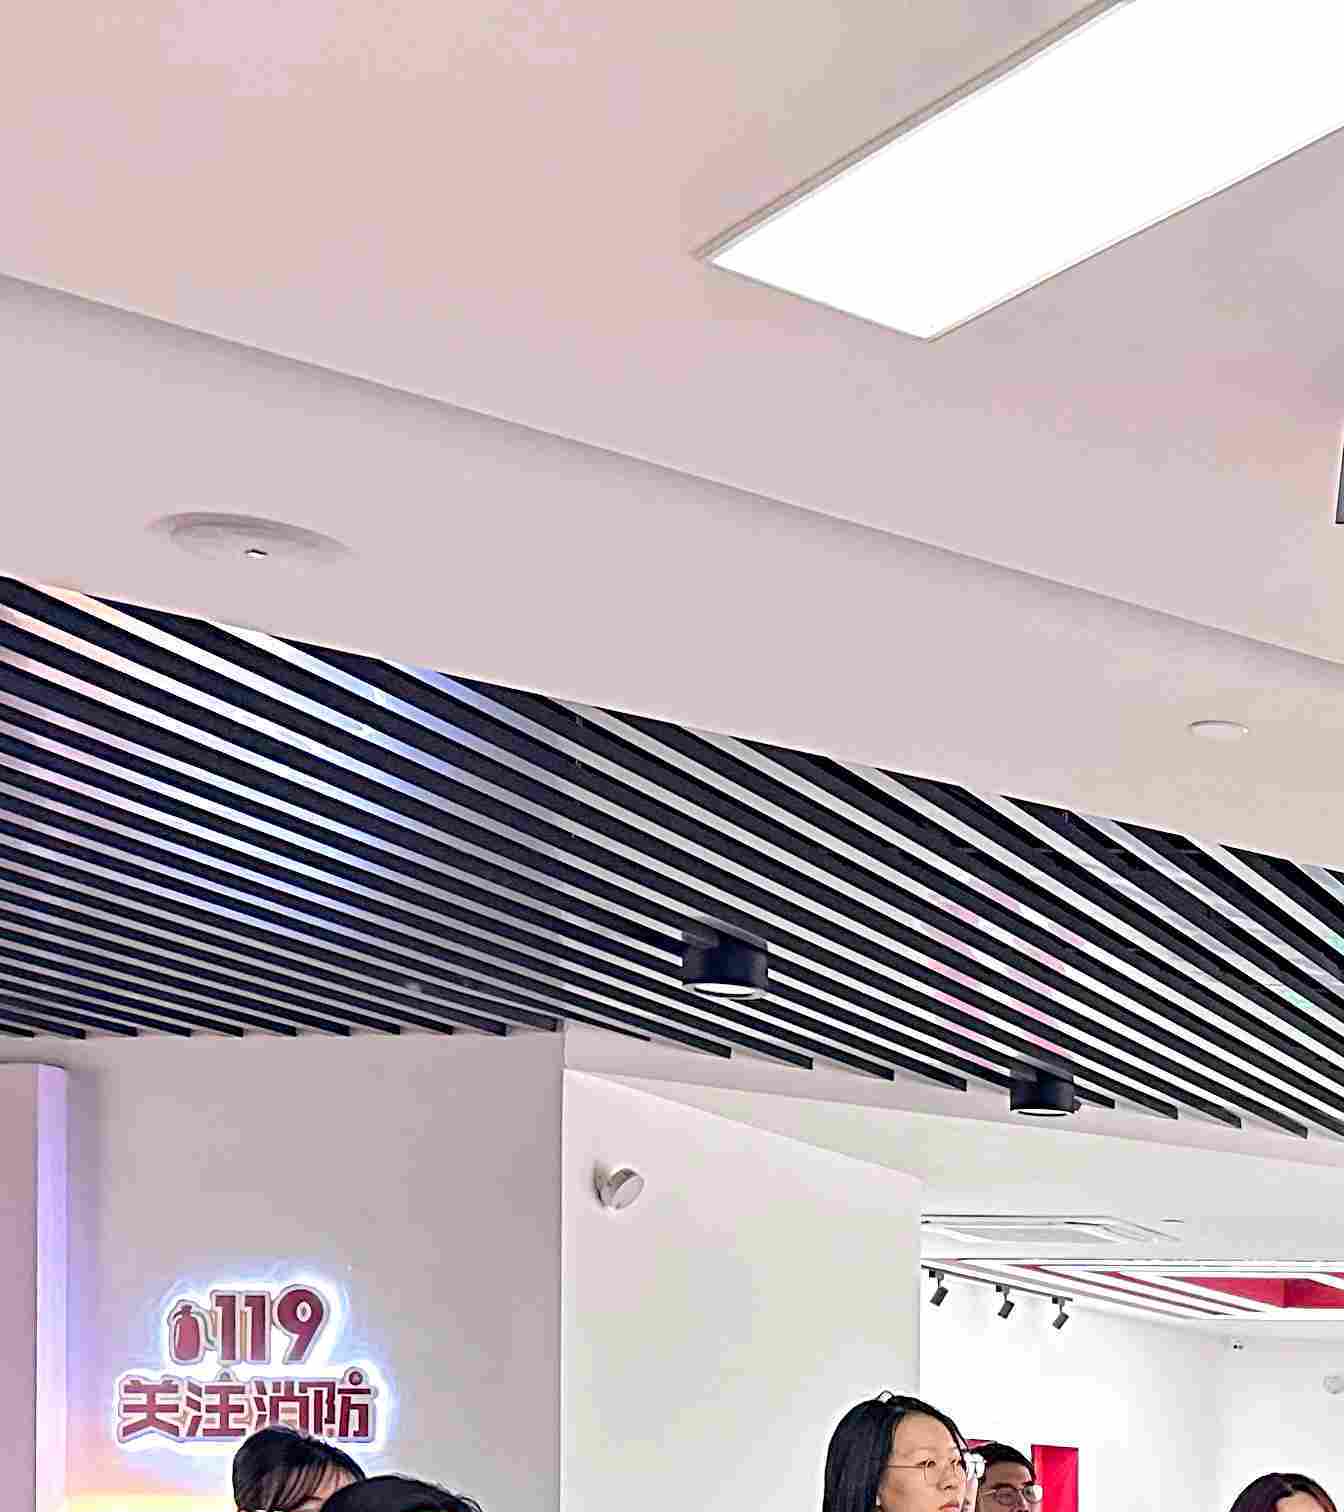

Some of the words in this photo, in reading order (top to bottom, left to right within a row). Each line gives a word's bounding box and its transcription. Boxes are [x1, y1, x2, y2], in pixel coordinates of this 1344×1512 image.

[211, 1285, 329, 1363] 119
[118, 1370, 379, 1443] 关注消防
